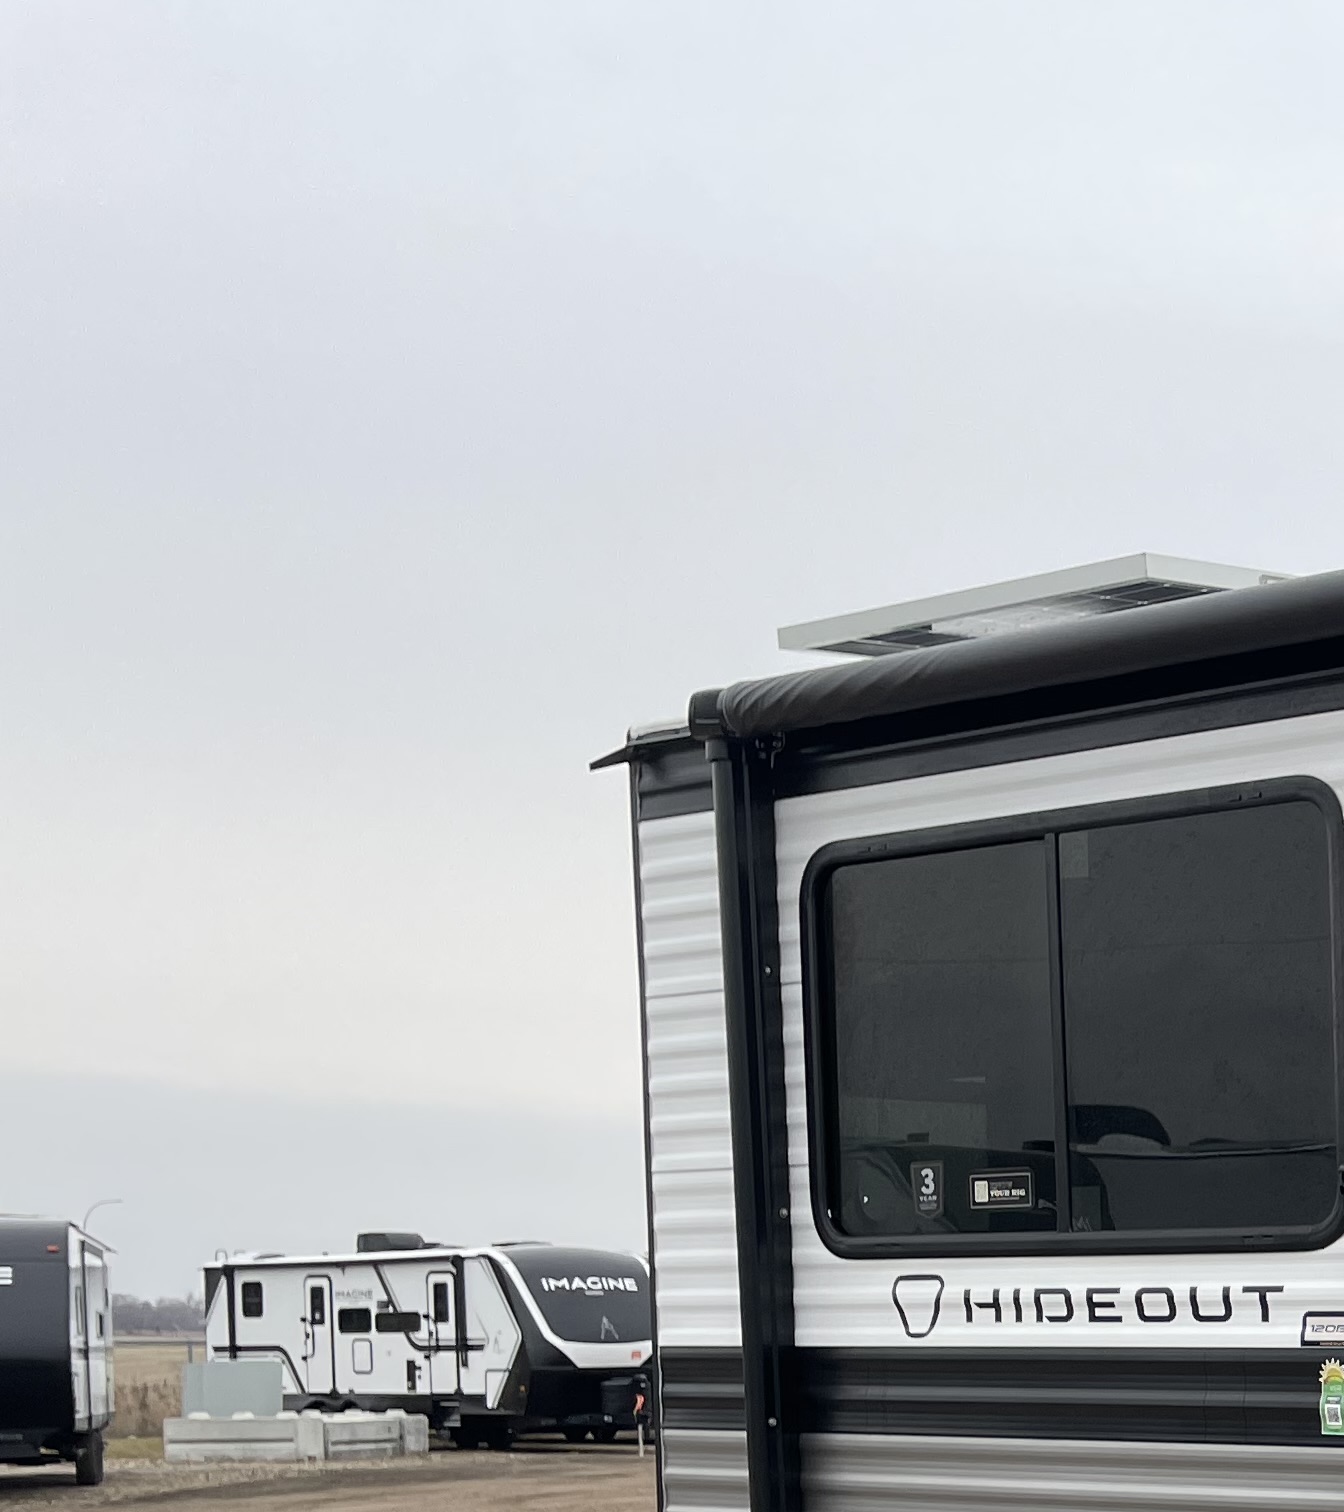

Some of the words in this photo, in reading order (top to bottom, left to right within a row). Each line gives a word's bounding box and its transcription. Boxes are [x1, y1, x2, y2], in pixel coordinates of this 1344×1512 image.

[920, 1168, 935, 1195] 3
[1011, 1188, 1026, 1196] RIG
[541, 1276, 638, 1292] IMAGINE
[964, 1285, 1284, 1324] HIDEOUT
